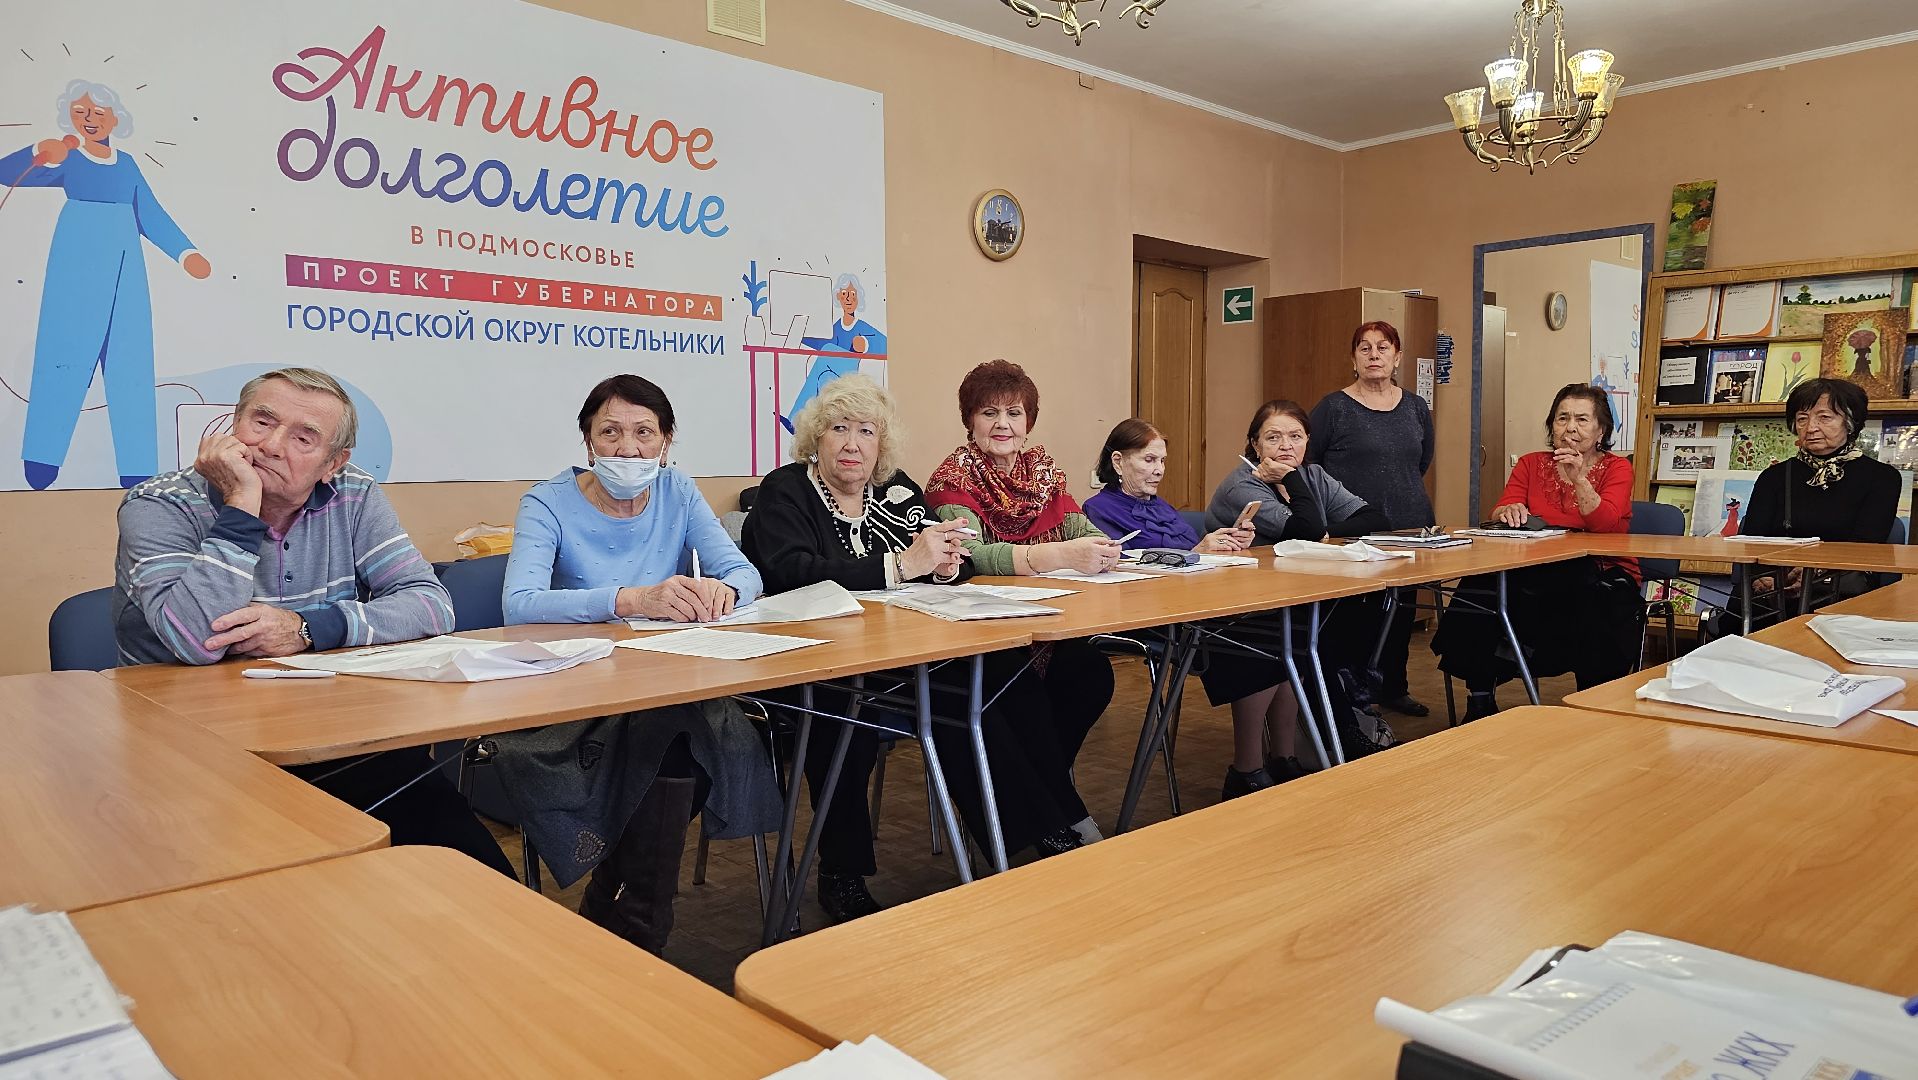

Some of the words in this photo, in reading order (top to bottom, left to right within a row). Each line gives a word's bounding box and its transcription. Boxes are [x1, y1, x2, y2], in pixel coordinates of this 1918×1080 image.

[272, 25, 718, 171] Активное
[277, 95, 730, 238] долголетие
[410, 225, 424, 245] В
[437, 228, 635, 269] ПОДМОСКОВЬЕ
[303, 261, 454, 292] ПРОЕКТ
[492, 279, 716, 317] ГУБЕРНАТОРА
[287, 304, 475, 342] ГОРОДСКОЙ
[484, 318, 565, 345] ОКРУГ
[573, 324, 725, 356] КОТЕЛЬНИКИ
